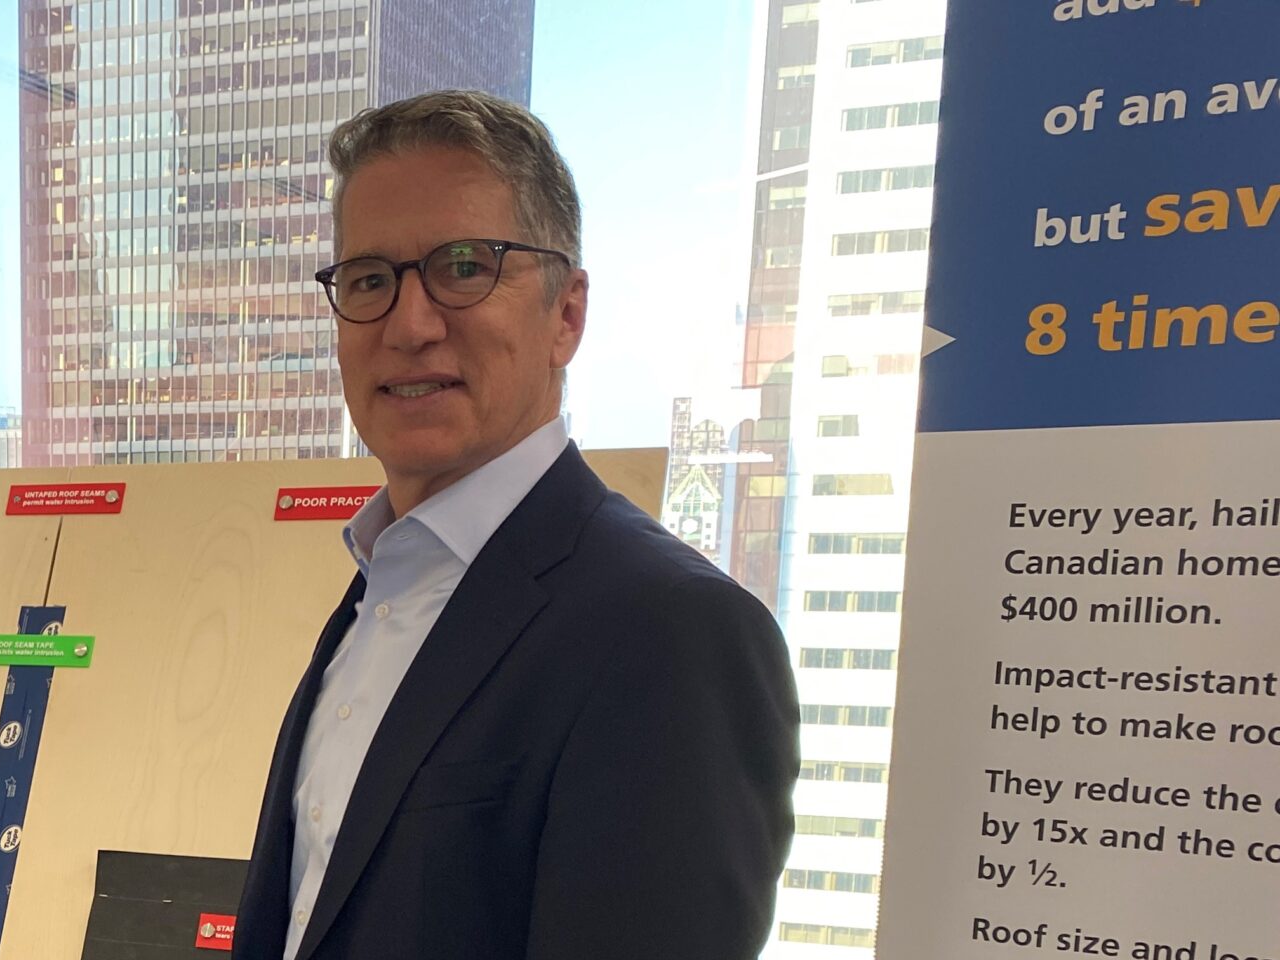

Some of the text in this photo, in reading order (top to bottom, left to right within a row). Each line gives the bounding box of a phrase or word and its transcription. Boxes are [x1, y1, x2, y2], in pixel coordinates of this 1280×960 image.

[1043, 88, 1187, 135] of an
[1033, 183, 1280, 248] but sav
[1024, 293, 1280, 356] 8 time
[23, 499, 44, 507] permit
[25, 489, 105, 499] UNTAPED ROOF SEAMS
[294, 497, 327, 507] POOR
[1008, 498, 1280, 534] Every year, hail
[1004, 548, 1280, 577] Canadian home
[1000, 593, 1222, 625] $400 million.
[993, 661, 1278, 697] Impact-resistant
[10, 724, 18, 743] Tape
[990, 704, 1216, 742] help to make
